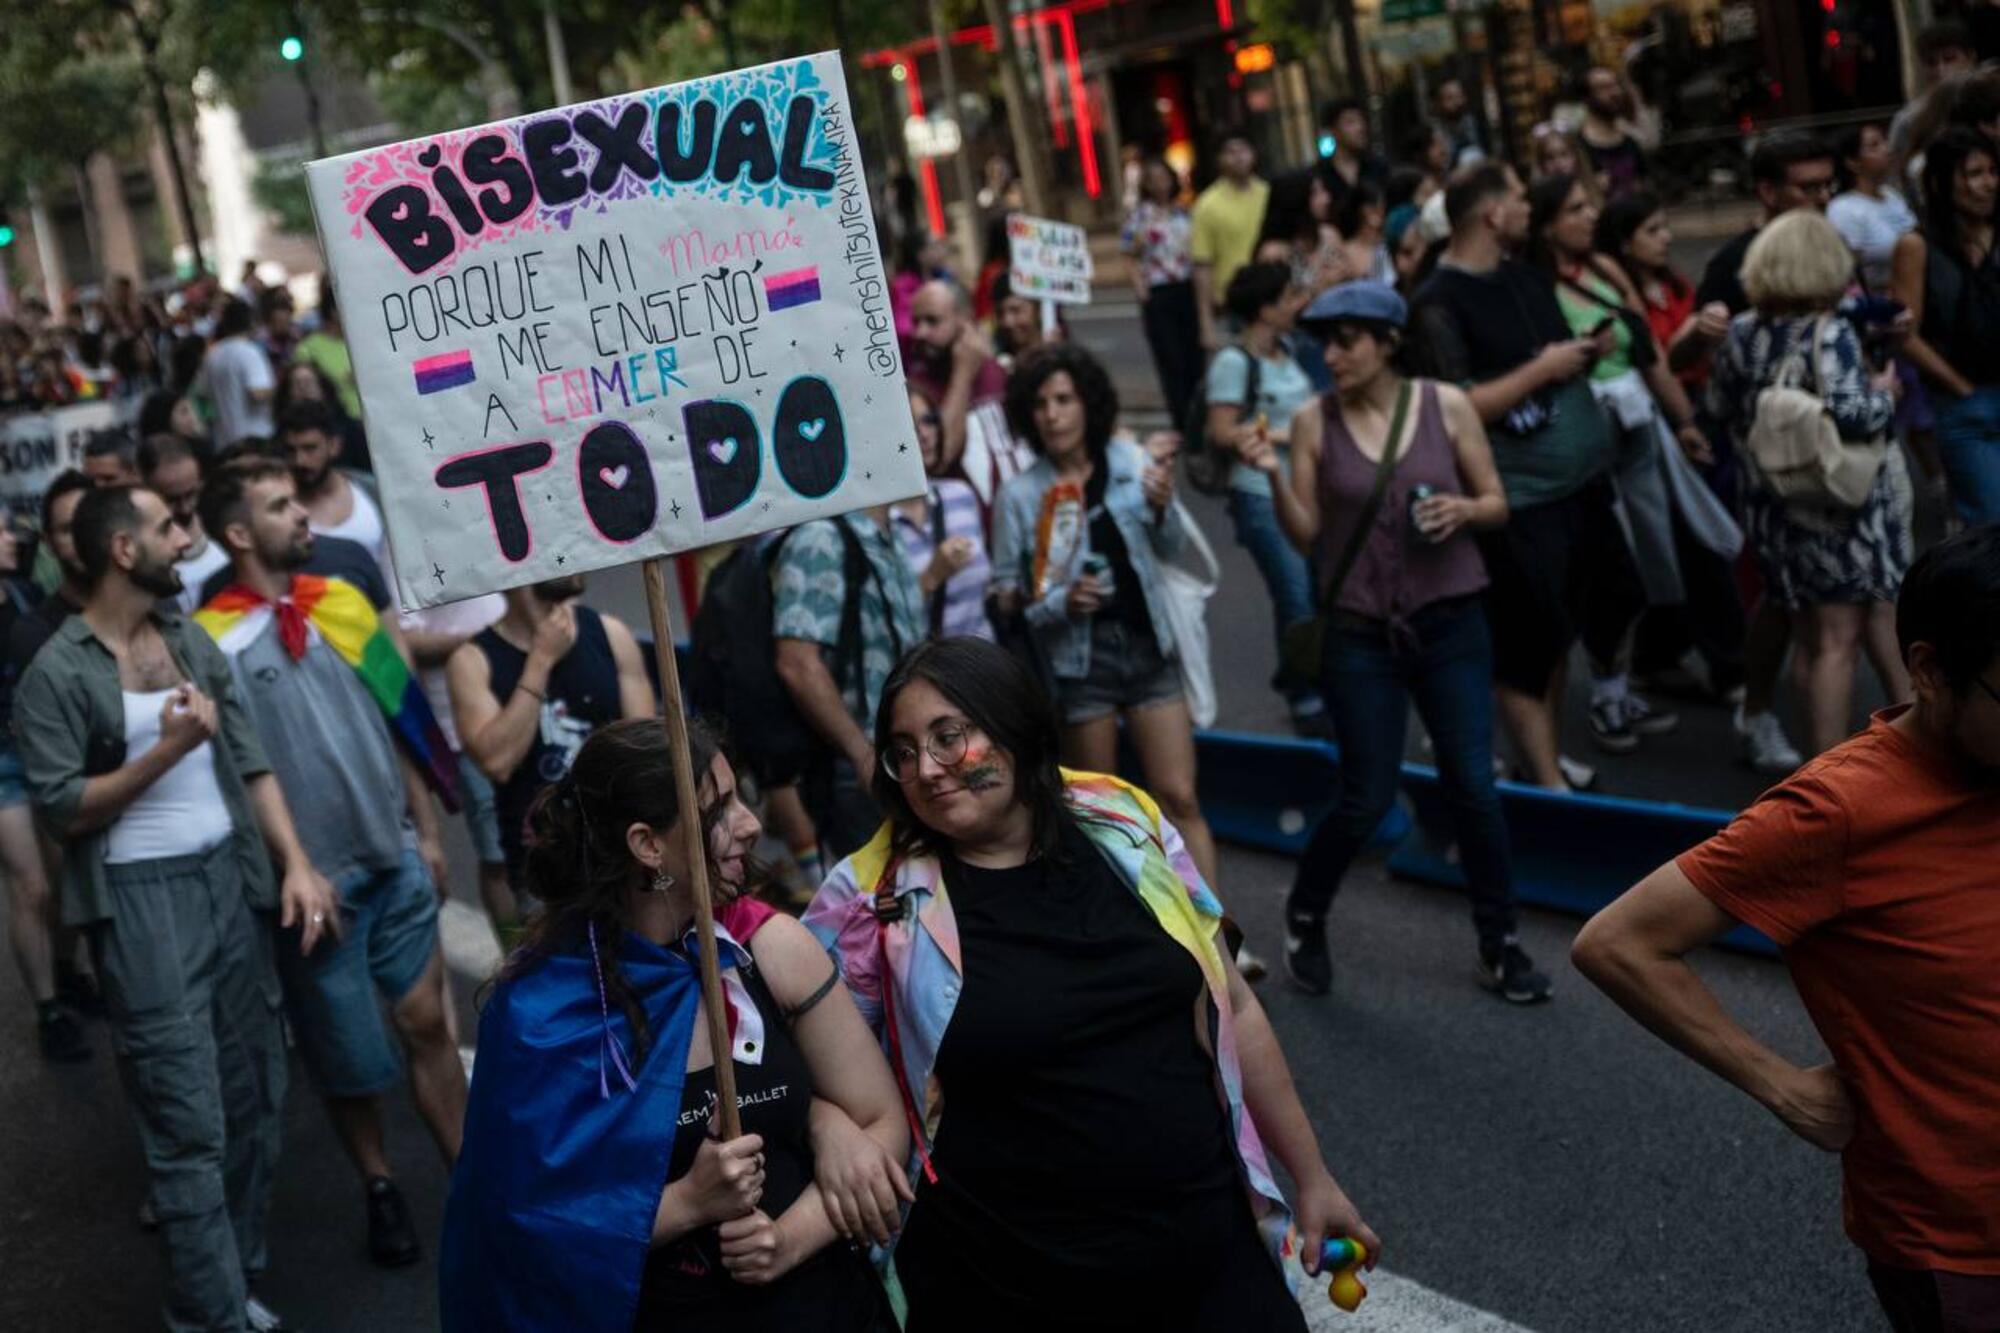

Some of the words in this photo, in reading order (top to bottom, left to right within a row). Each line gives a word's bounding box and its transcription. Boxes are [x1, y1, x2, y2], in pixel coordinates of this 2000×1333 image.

[382, 250, 555, 352] PORQUE
[576, 233, 637, 301] MI
[484, 392, 518, 438] A
[537, 345, 688, 425] COMER
[713, 327, 768, 384] DE
[497, 321, 563, 380] ME
[435, 375, 848, 564] TODO
